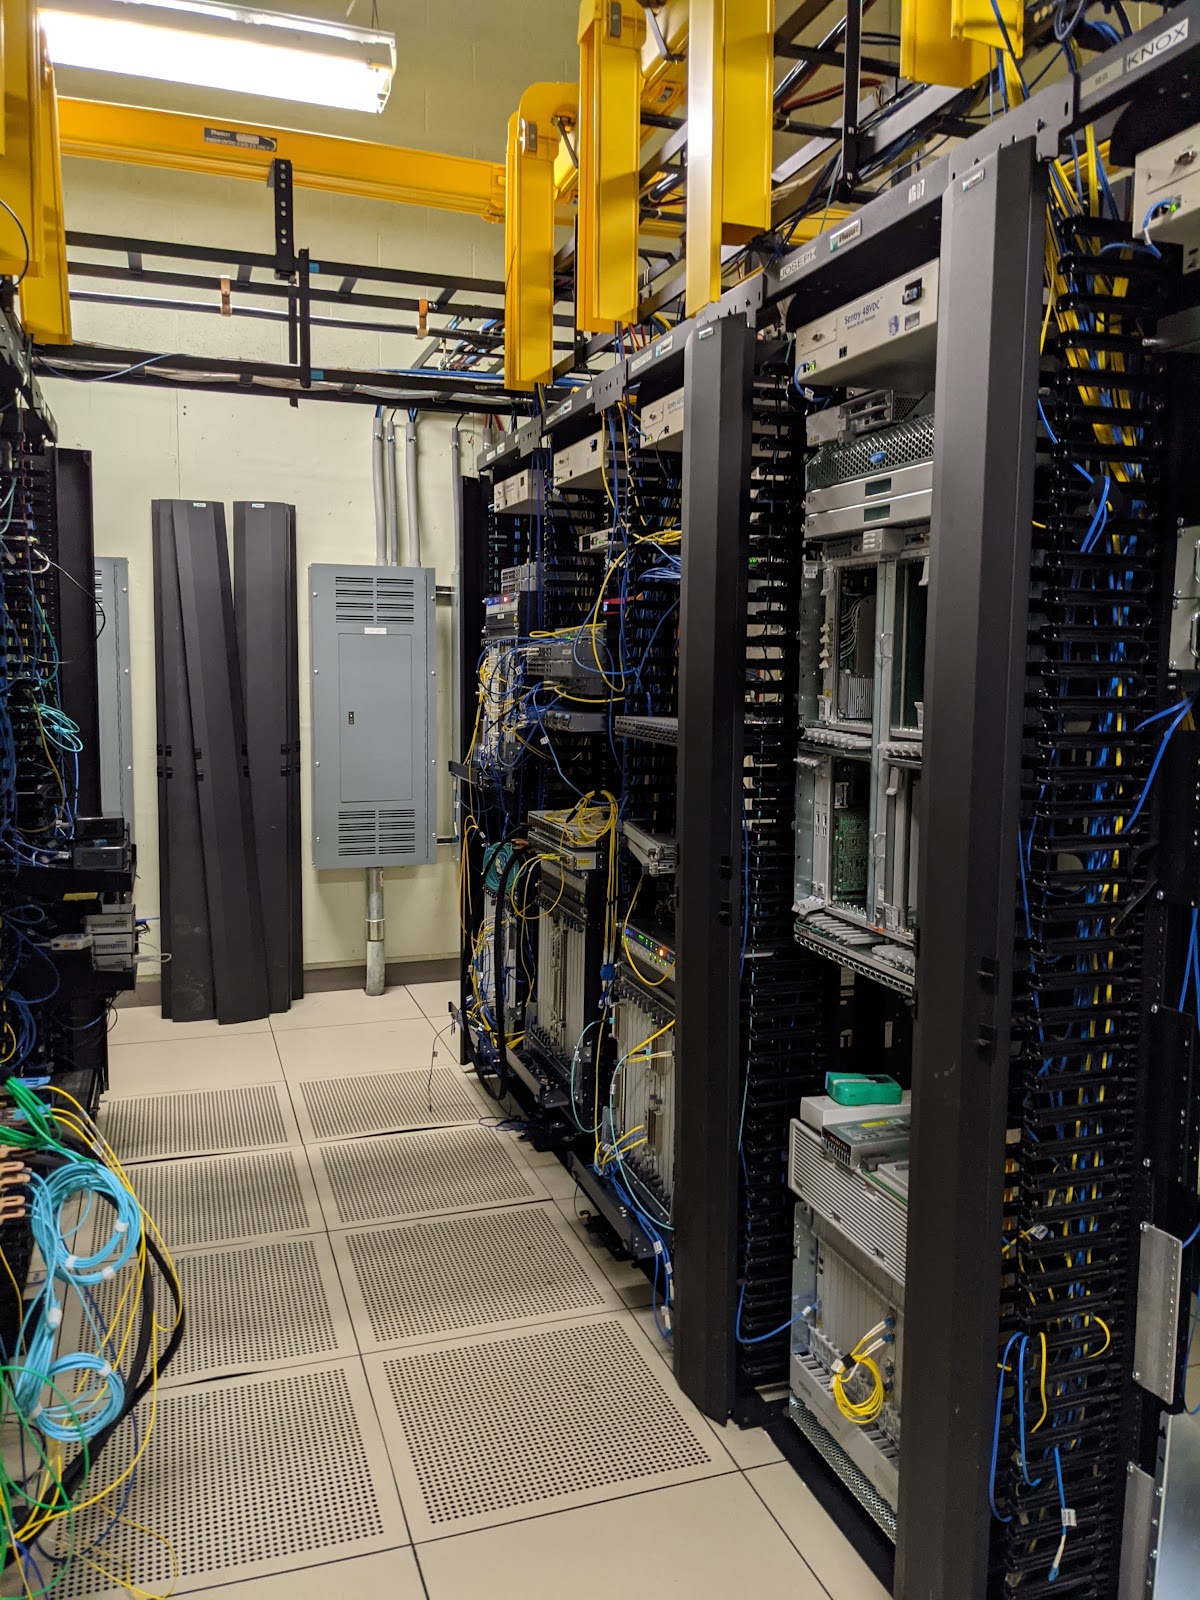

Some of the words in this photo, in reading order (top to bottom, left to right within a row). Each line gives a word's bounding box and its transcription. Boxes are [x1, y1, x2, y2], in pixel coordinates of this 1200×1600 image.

[1128, 23, 1186, 69] KNOX
[780, 249, 817, 279] JOSEPH
[844, 310, 862, 325] Sentry
